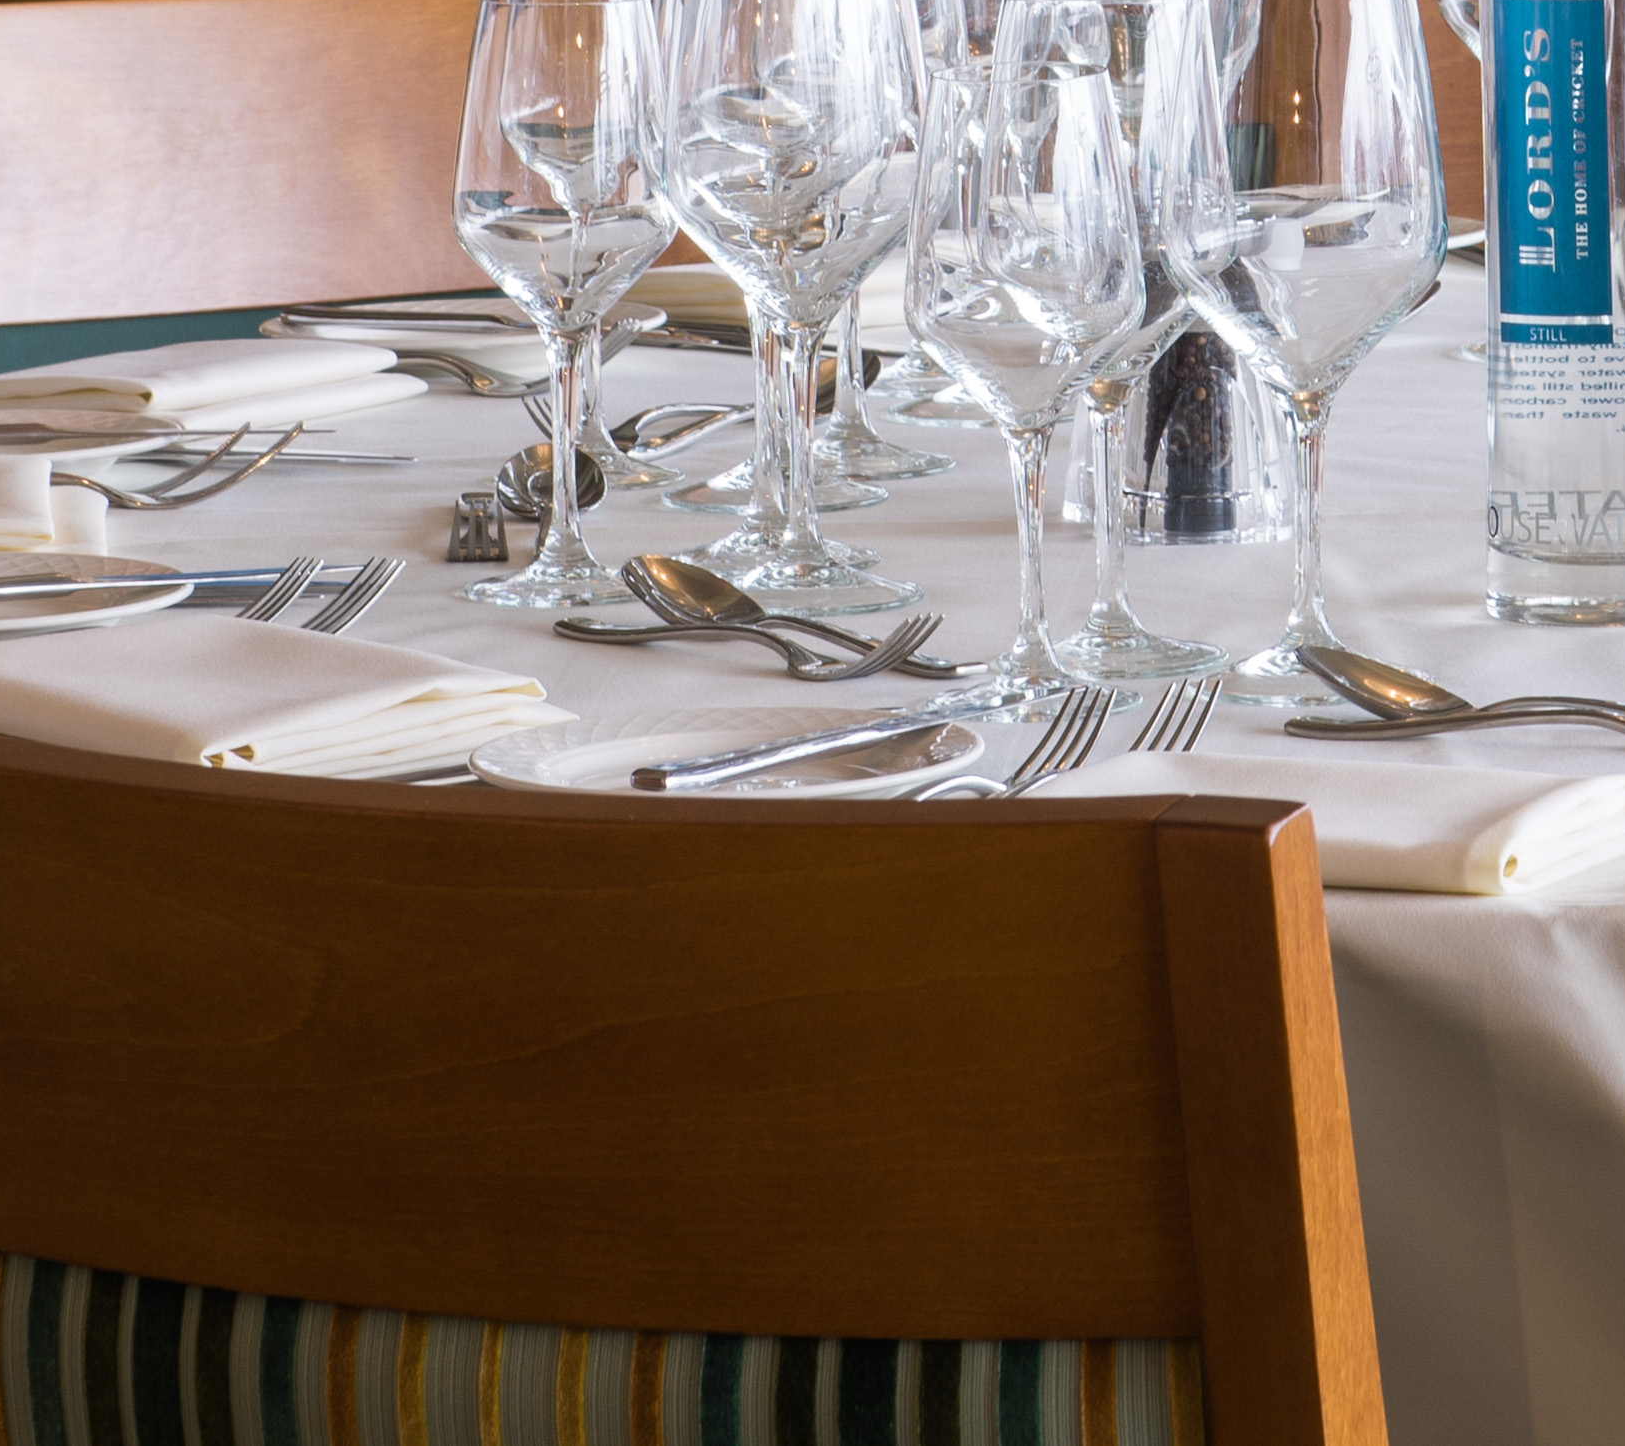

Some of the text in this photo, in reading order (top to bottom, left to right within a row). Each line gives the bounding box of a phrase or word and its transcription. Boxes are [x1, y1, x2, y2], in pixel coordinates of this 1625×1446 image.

[1518, 28, 1556, 273] LORD'S
[1570, 38, 1589, 260] THE HOME OF CRICKET
[1530, 327, 1567, 342] STILL
